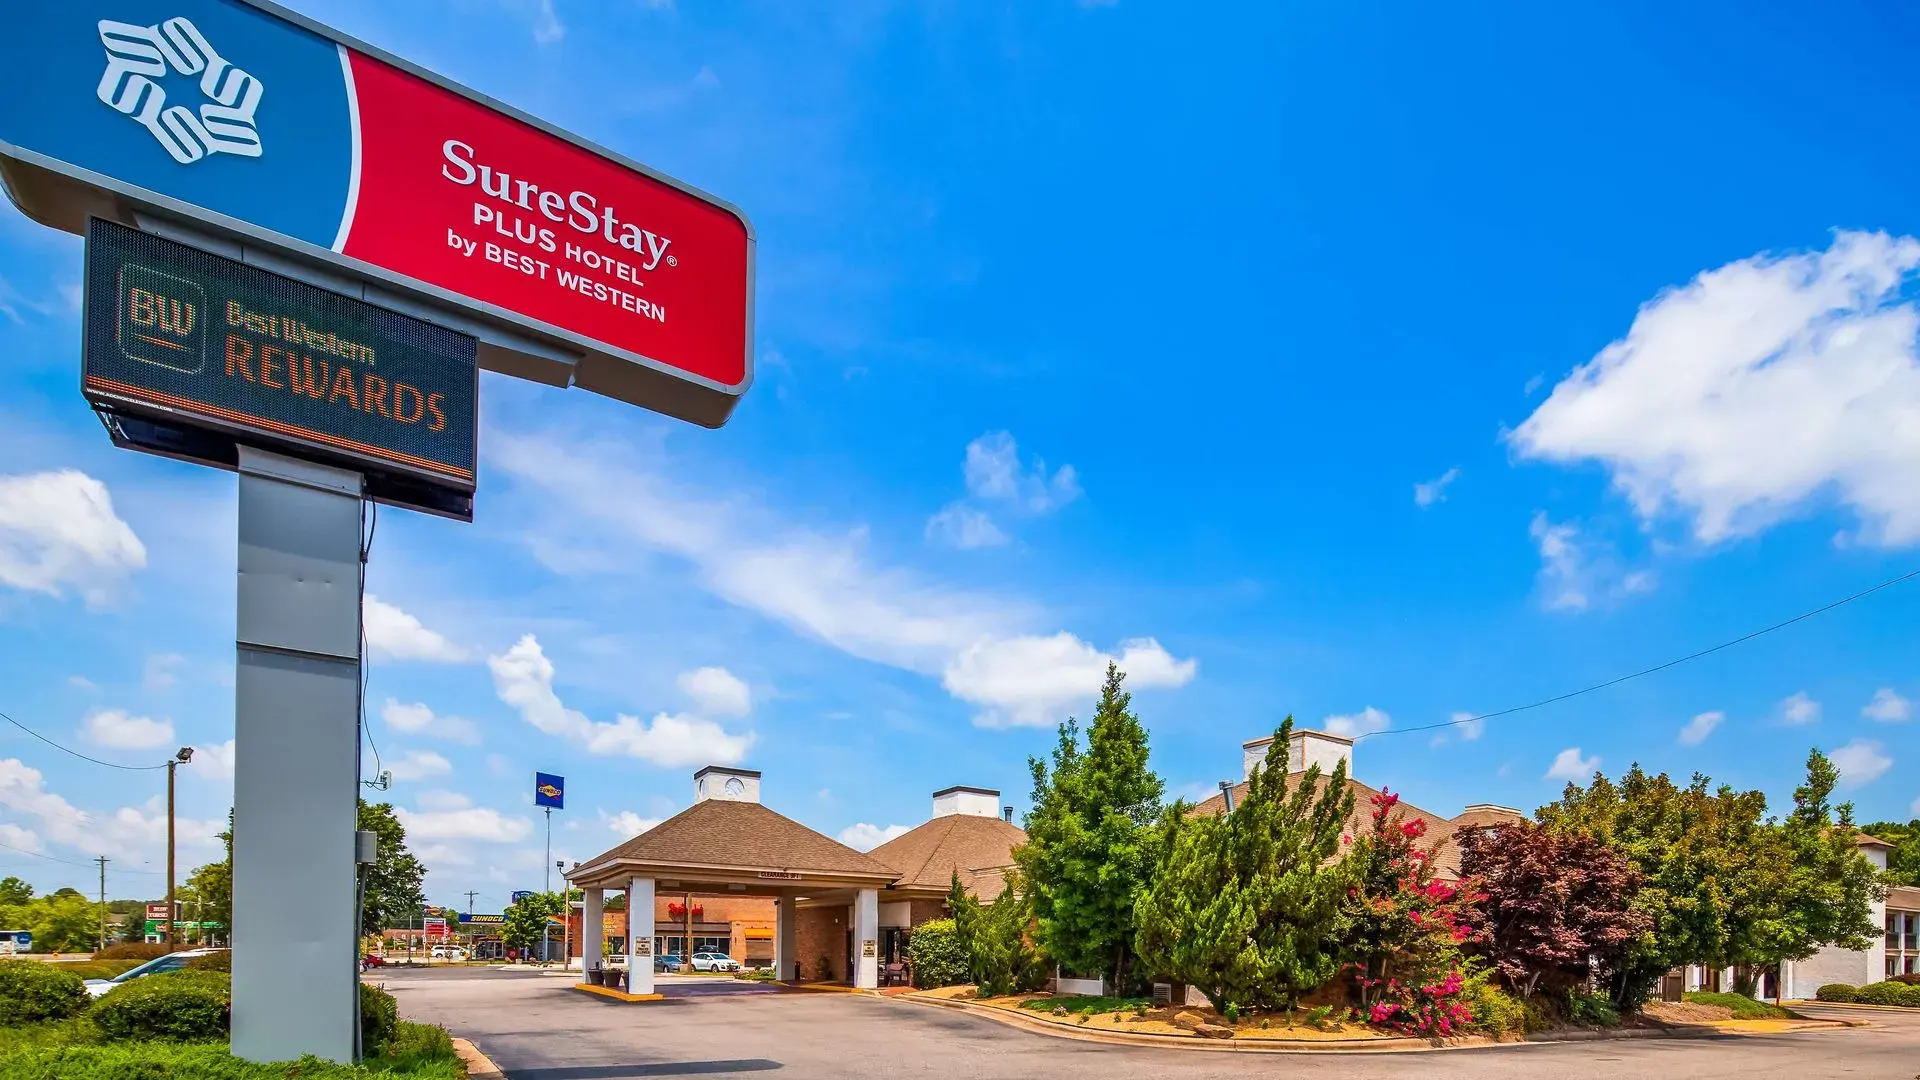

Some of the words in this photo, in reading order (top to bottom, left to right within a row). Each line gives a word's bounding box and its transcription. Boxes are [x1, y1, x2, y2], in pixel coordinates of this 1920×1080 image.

[441, 139, 672, 272] SureStay
[473, 202, 557, 253] PLUS
[565, 242, 645, 287] HOTEL
[130, 287, 196, 337] BW
[447, 228, 478, 258] by
[485, 241, 550, 280] BEST
[556, 267, 666, 324] WESTERN
[226, 299, 280, 337] Best
[280, 314, 376, 366] Western
[224, 333, 447, 432] REWARDS
[470, 914, 505, 922] SUNOCO
